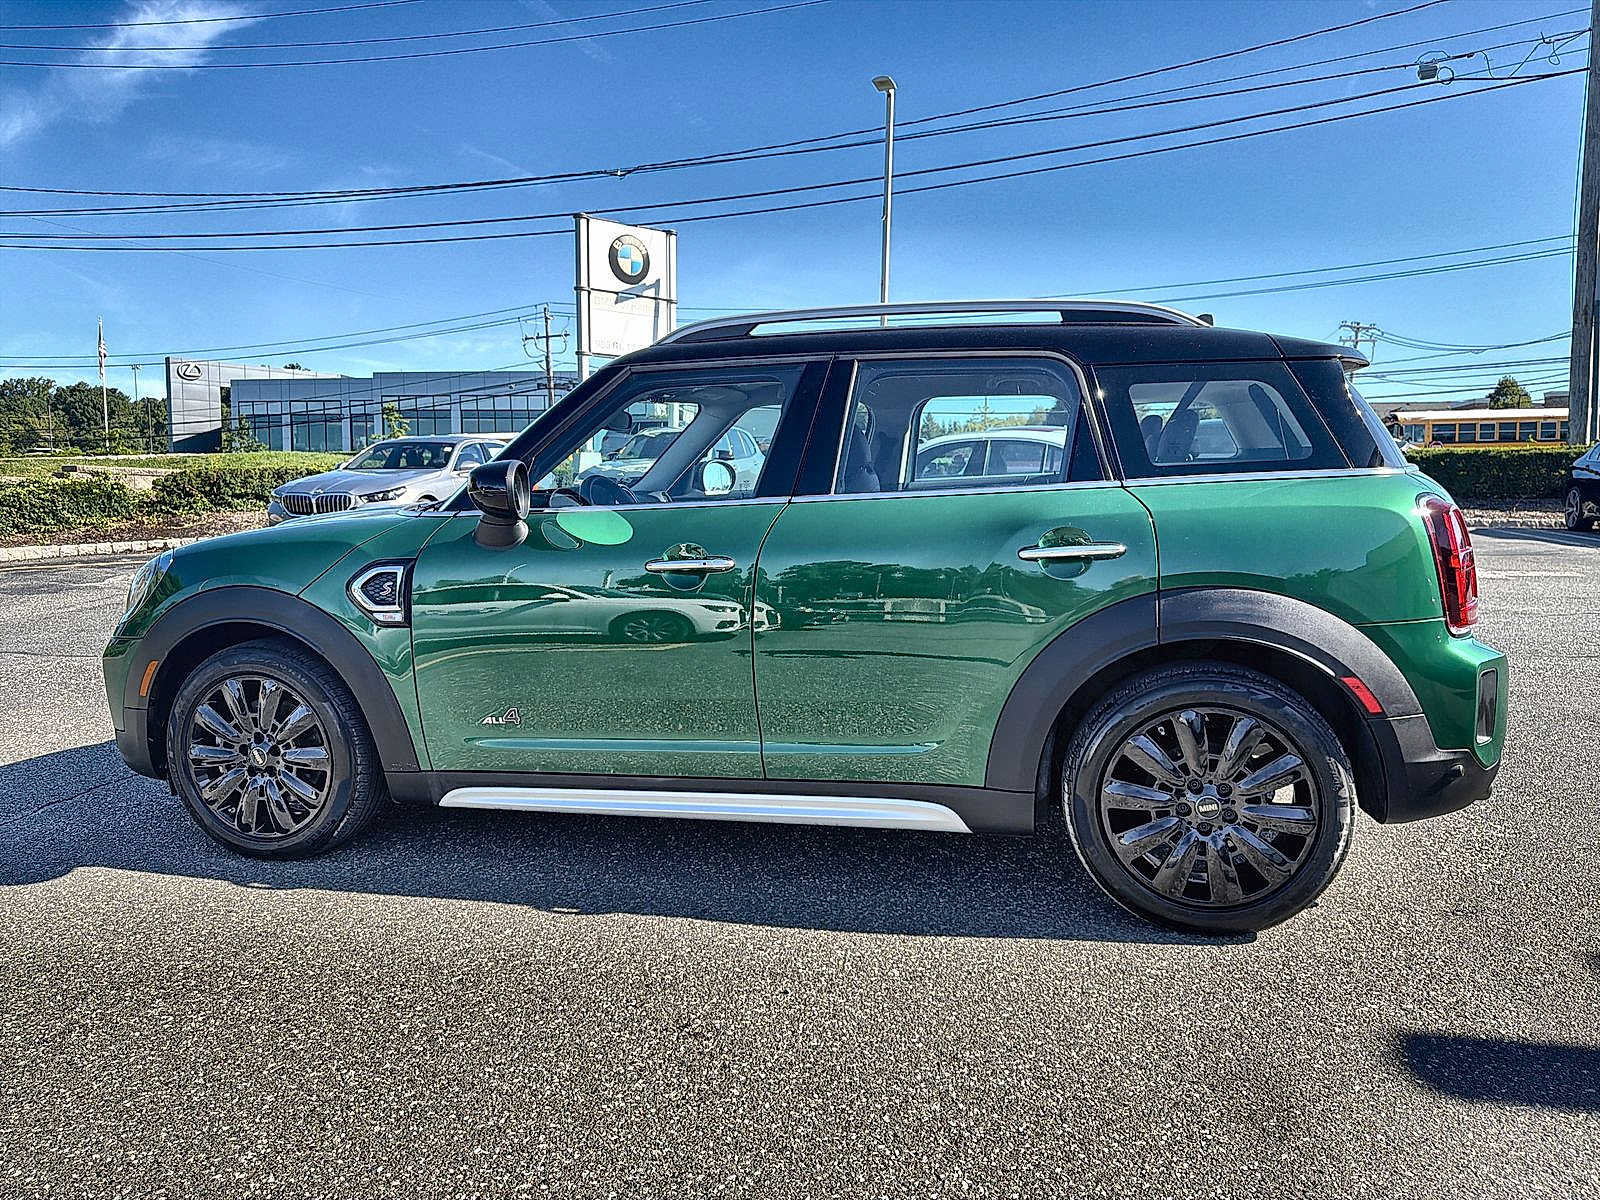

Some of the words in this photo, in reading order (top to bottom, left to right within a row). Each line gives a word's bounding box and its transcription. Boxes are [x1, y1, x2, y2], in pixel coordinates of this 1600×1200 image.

[380, 581, 394, 596] S
[482, 707, 520, 725] ALL4
[1198, 803, 1219, 813] MINI
